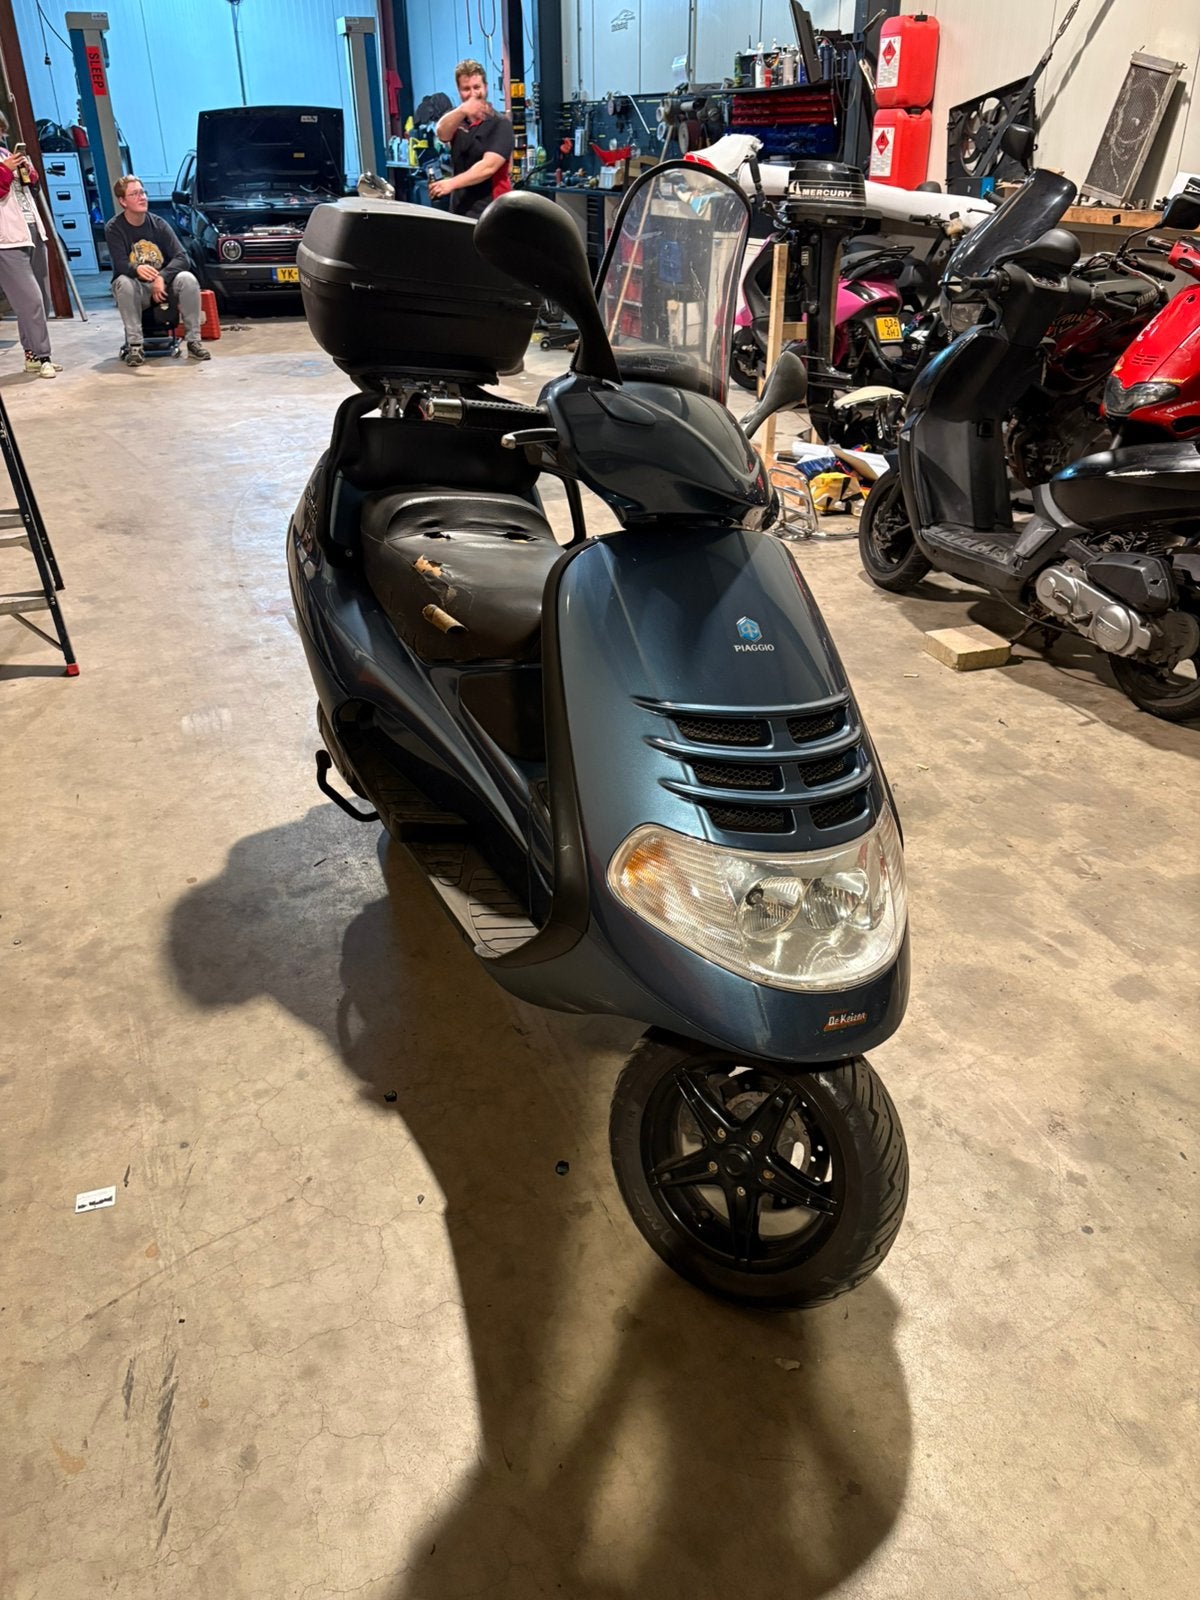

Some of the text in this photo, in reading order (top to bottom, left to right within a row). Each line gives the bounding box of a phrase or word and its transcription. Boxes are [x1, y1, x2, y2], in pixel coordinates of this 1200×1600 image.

[88, 52, 105, 89] SLEEP
[802, 188, 852, 197] MERCURY
[733, 644, 775, 652] PIAGGIO
